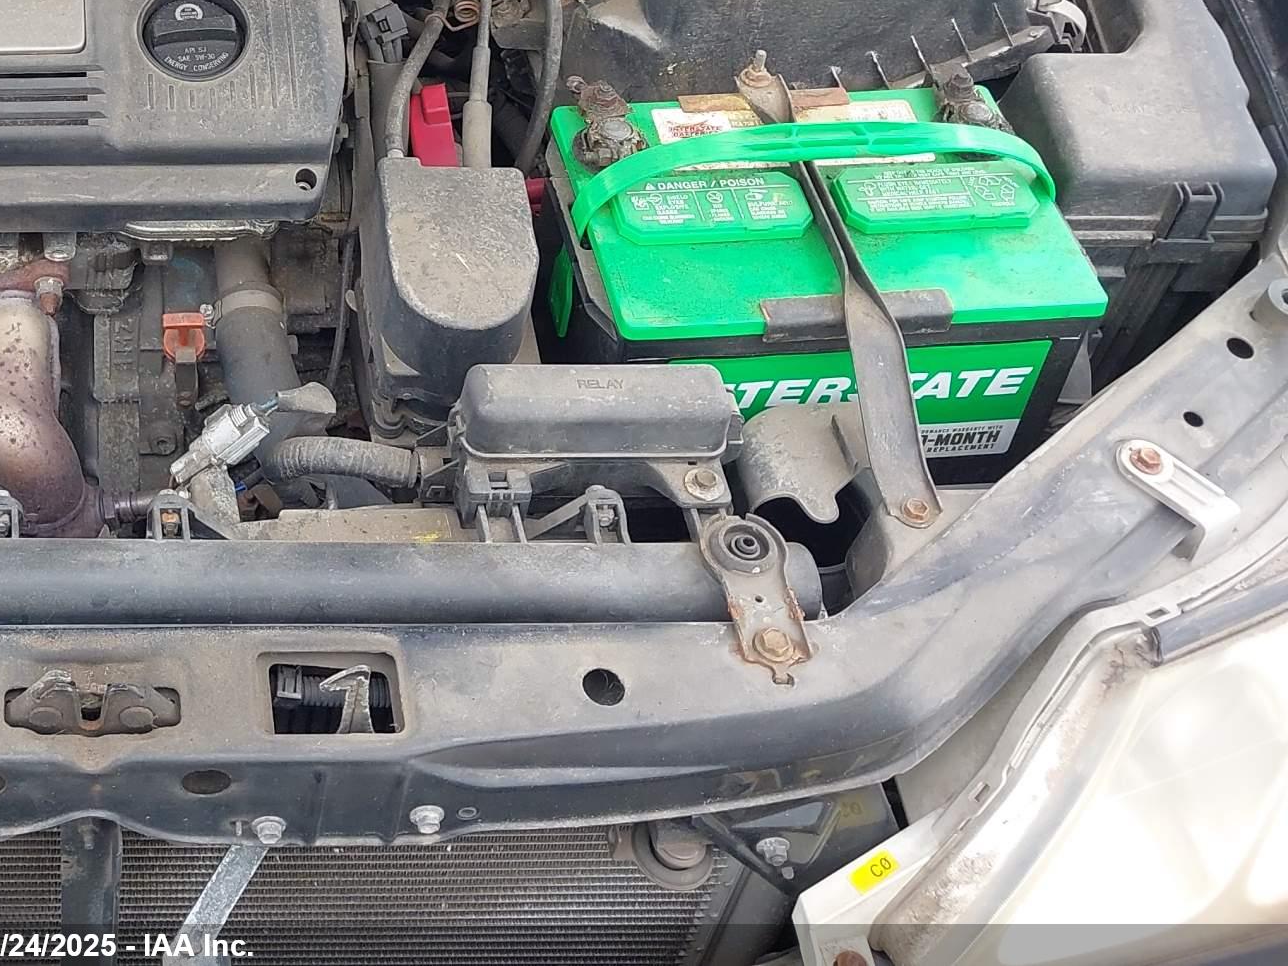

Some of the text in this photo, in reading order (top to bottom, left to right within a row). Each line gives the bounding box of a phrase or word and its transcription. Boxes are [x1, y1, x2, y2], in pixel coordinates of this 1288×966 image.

[163, 51, 229, 72] ENERGY CONSERVING
[194, 53, 215, 61] 5W-30
[658, 179, 707, 190] DANGER
[719, 177, 765, 188] POISON
[576, 378, 623, 389] RELAY
[926, 444, 994, 453] REPLACEMENT
